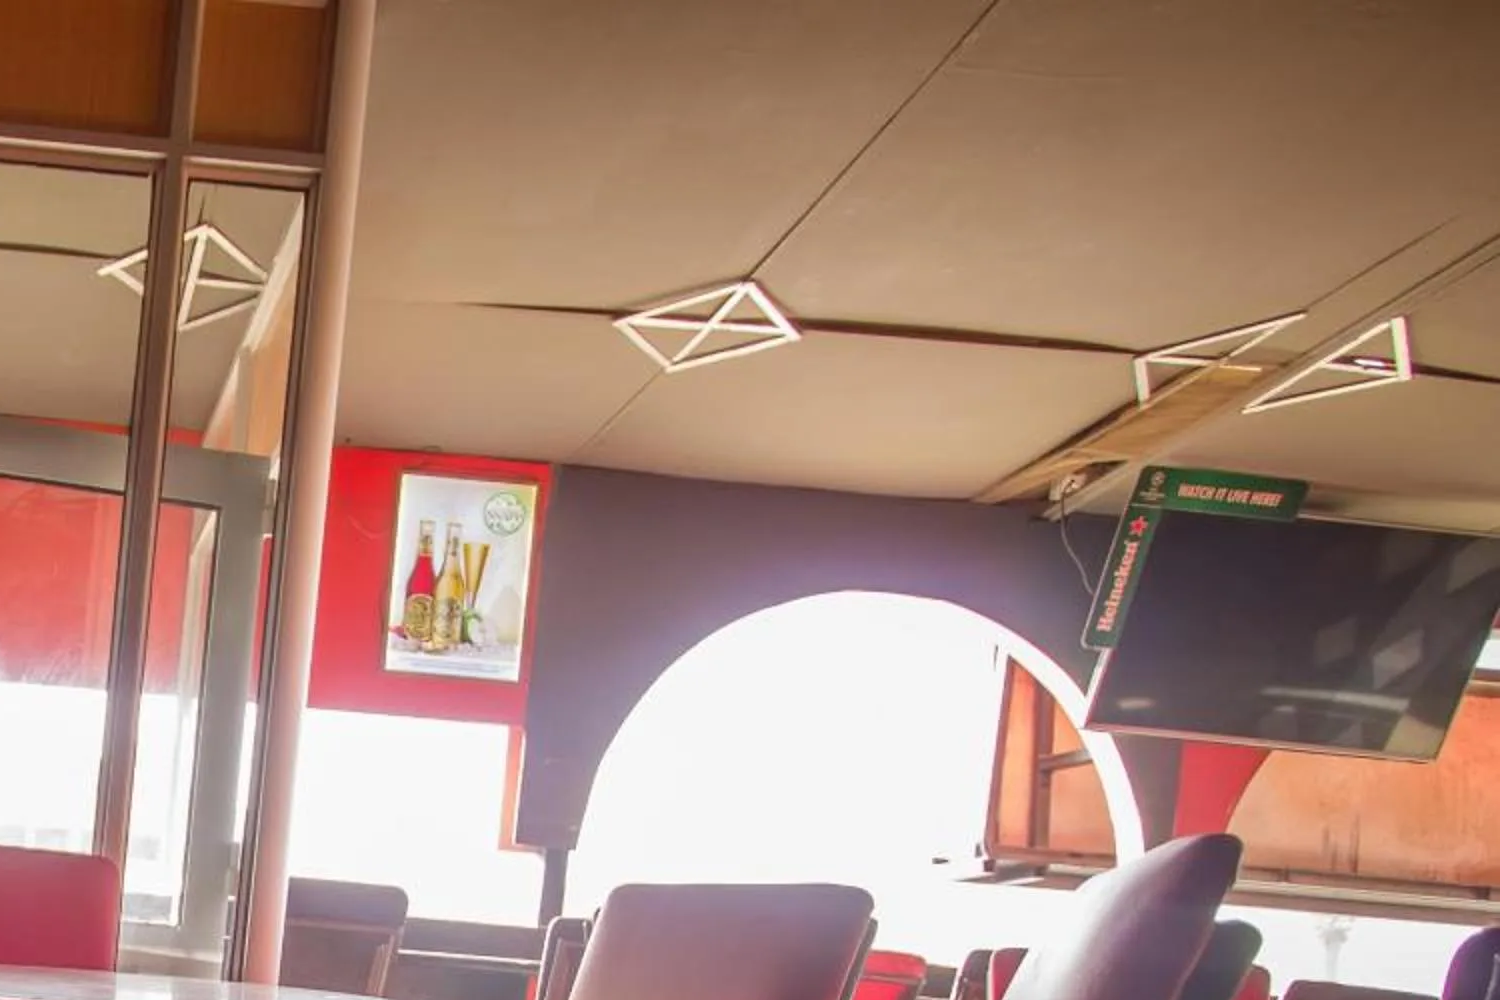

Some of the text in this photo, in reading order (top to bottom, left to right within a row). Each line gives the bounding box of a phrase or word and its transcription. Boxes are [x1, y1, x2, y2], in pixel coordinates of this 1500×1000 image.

[1178, 484, 1217, 500] WATCH
[1214, 487, 1229, 502] IT
[1226, 488, 1252, 504] LIVE
[1096, 539, 1139, 632] Heineken
